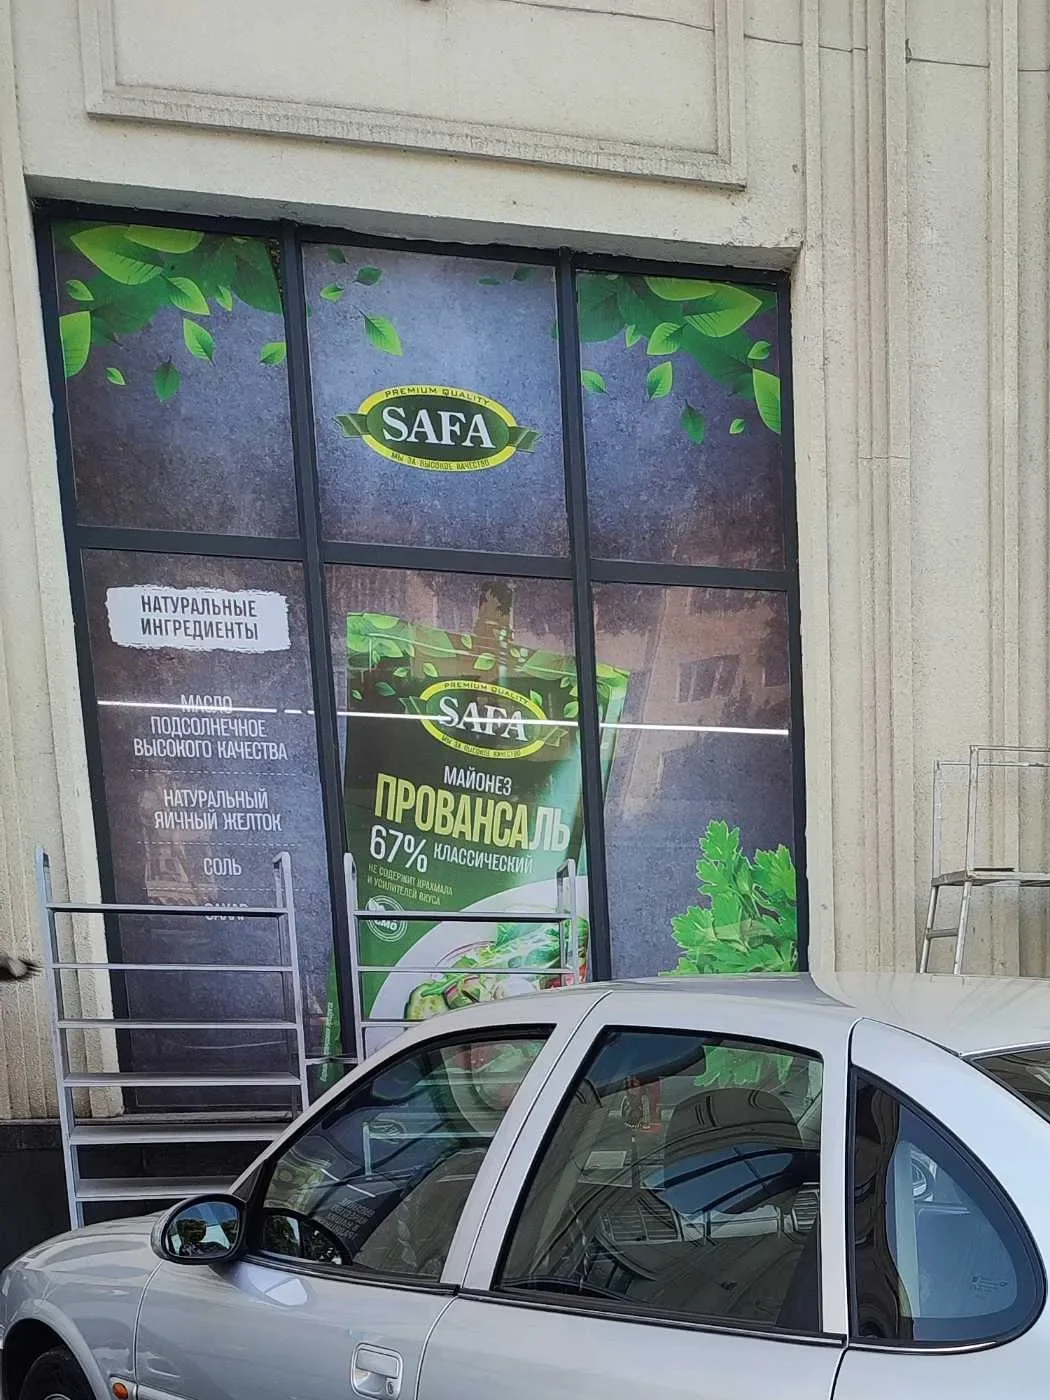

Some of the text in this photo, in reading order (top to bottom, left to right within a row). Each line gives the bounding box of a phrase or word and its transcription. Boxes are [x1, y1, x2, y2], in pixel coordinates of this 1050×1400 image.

[384, 387, 491, 406] PREMIUM QUALITY
[382, 406, 497, 449] SAFA
[141, 595, 258, 618] НАТУРАЛЬНЫЕ
[140, 617, 259, 641] ИНГРЕДИЕНТЫ
[181, 694, 233, 714] МАСЛО
[444, 682, 529, 705] PREMIUM QUALITY
[150, 716, 268, 738] ПОДСОЛНЕЧНОЕ
[439, 695, 530, 742] SAFA
[133, 738, 288, 761] ВЫСОКОГО КАЧЕСТВА
[443, 765, 513, 796] МАЙОНЕЗ
[163, 788, 269, 809] НАТУРАЛЬНЫЙ
[154, 809, 283, 832] ЯИЧНЫЙ ЖЕЛТОК
[374, 772, 571, 852] ПРОВАНСАЛЬ
[369, 824, 534, 874] 67% КЛАССИЧЕСКИЙ
[203, 857, 242, 876] СОЛЬ
[368, 863, 378, 873] НЕ
[379, 866, 417, 886] СОДЕРЖИТ
[374, 878, 418, 900] УСИЛИТЕЛЕЙ
[418, 891, 441, 906] ВКУСА
